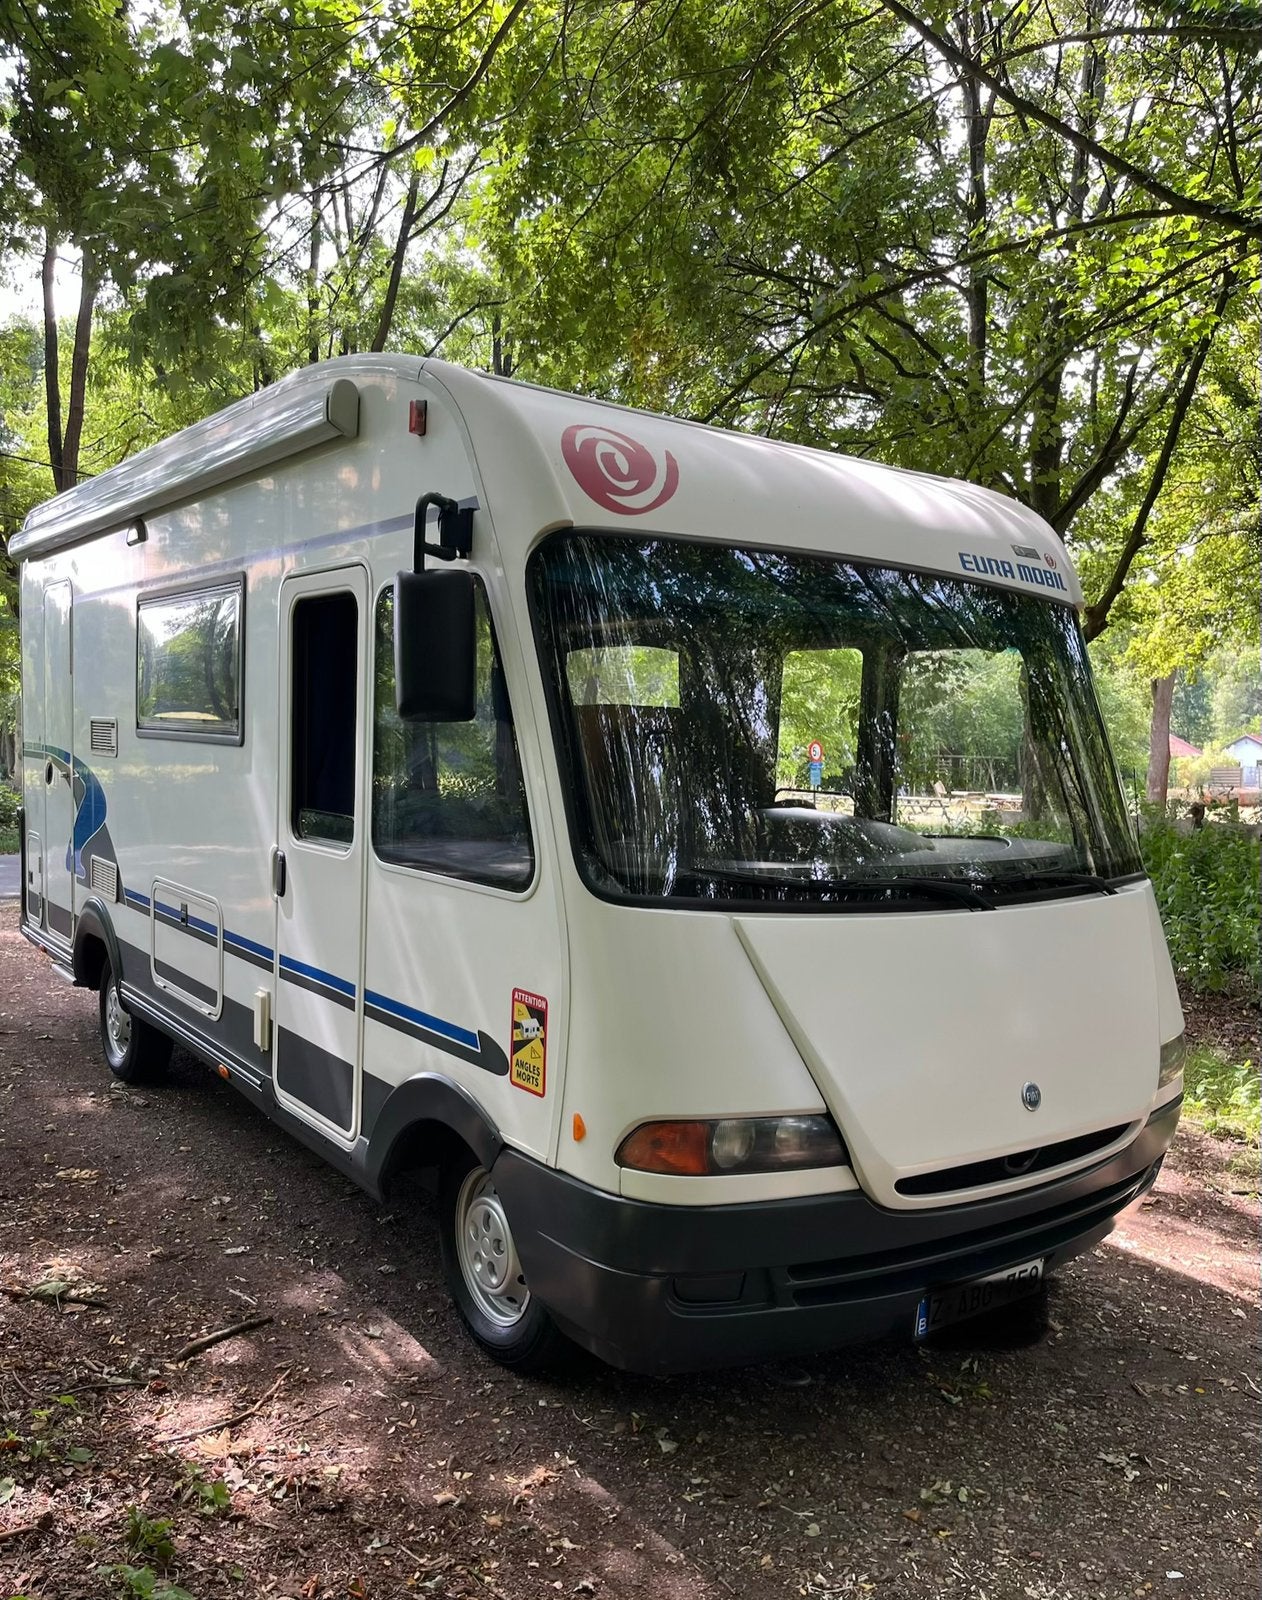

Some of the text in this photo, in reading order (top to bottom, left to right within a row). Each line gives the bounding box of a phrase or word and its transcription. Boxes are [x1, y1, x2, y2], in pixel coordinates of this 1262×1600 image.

[958, 552, 1015, 579] EURA
[1016, 563, 1067, 591] MOBIL
[514, 991, 546, 1010] ATTENTION
[515, 1058, 541, 1077] ANGLES
[516, 1069, 539, 1087] MORTS
[1026, 1090, 1039, 1102] FIAT
[918, 1317, 927, 1331] B
